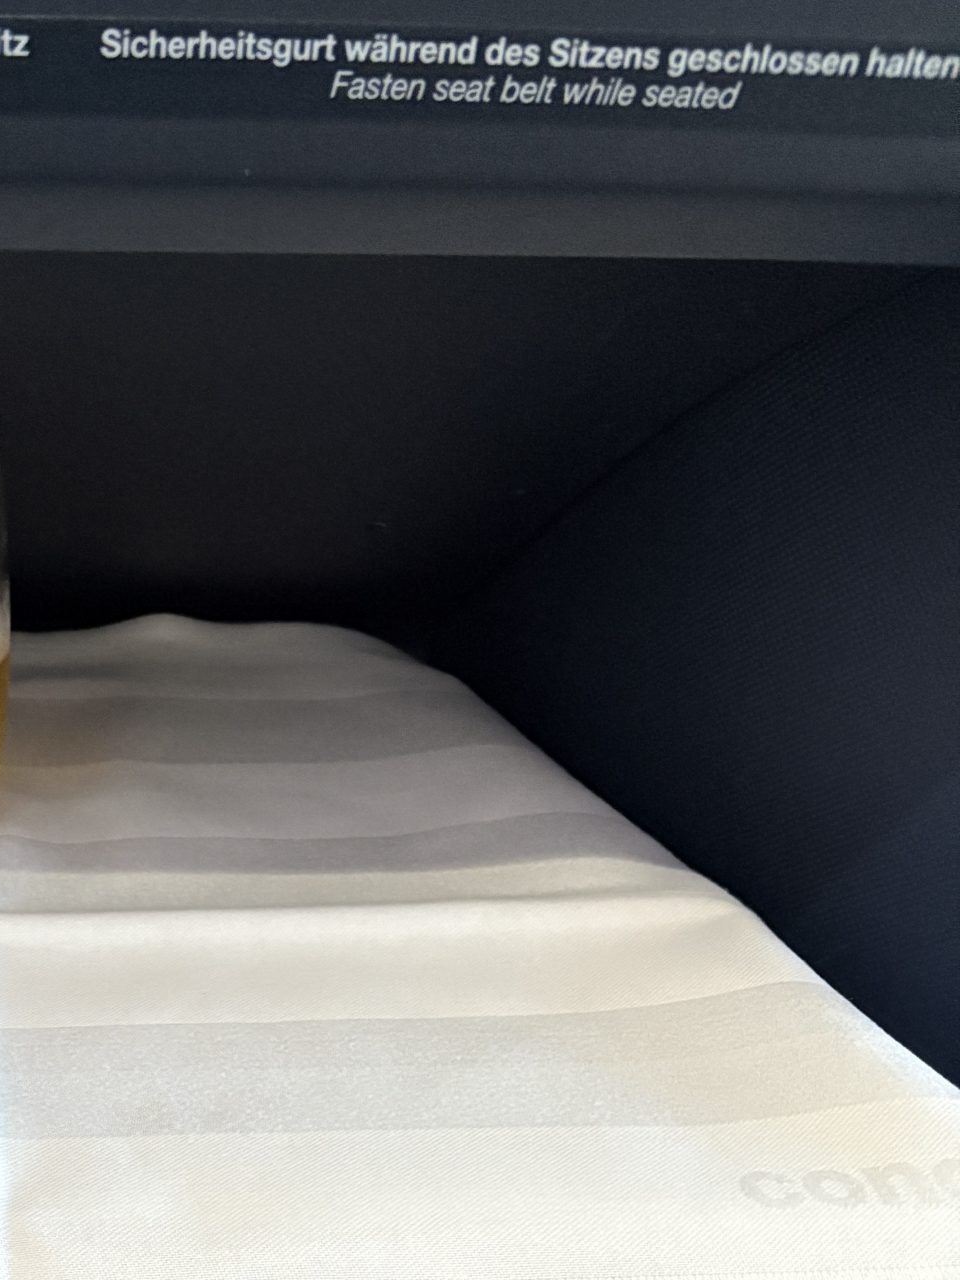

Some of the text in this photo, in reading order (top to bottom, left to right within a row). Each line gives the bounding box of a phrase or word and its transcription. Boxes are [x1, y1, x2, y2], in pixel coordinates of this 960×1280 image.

[100, 28, 960, 80] Sicherheitsgurt während des Sitzens geschlossen halten
[329, 70, 743, 110] Fasten seat belt while seated
